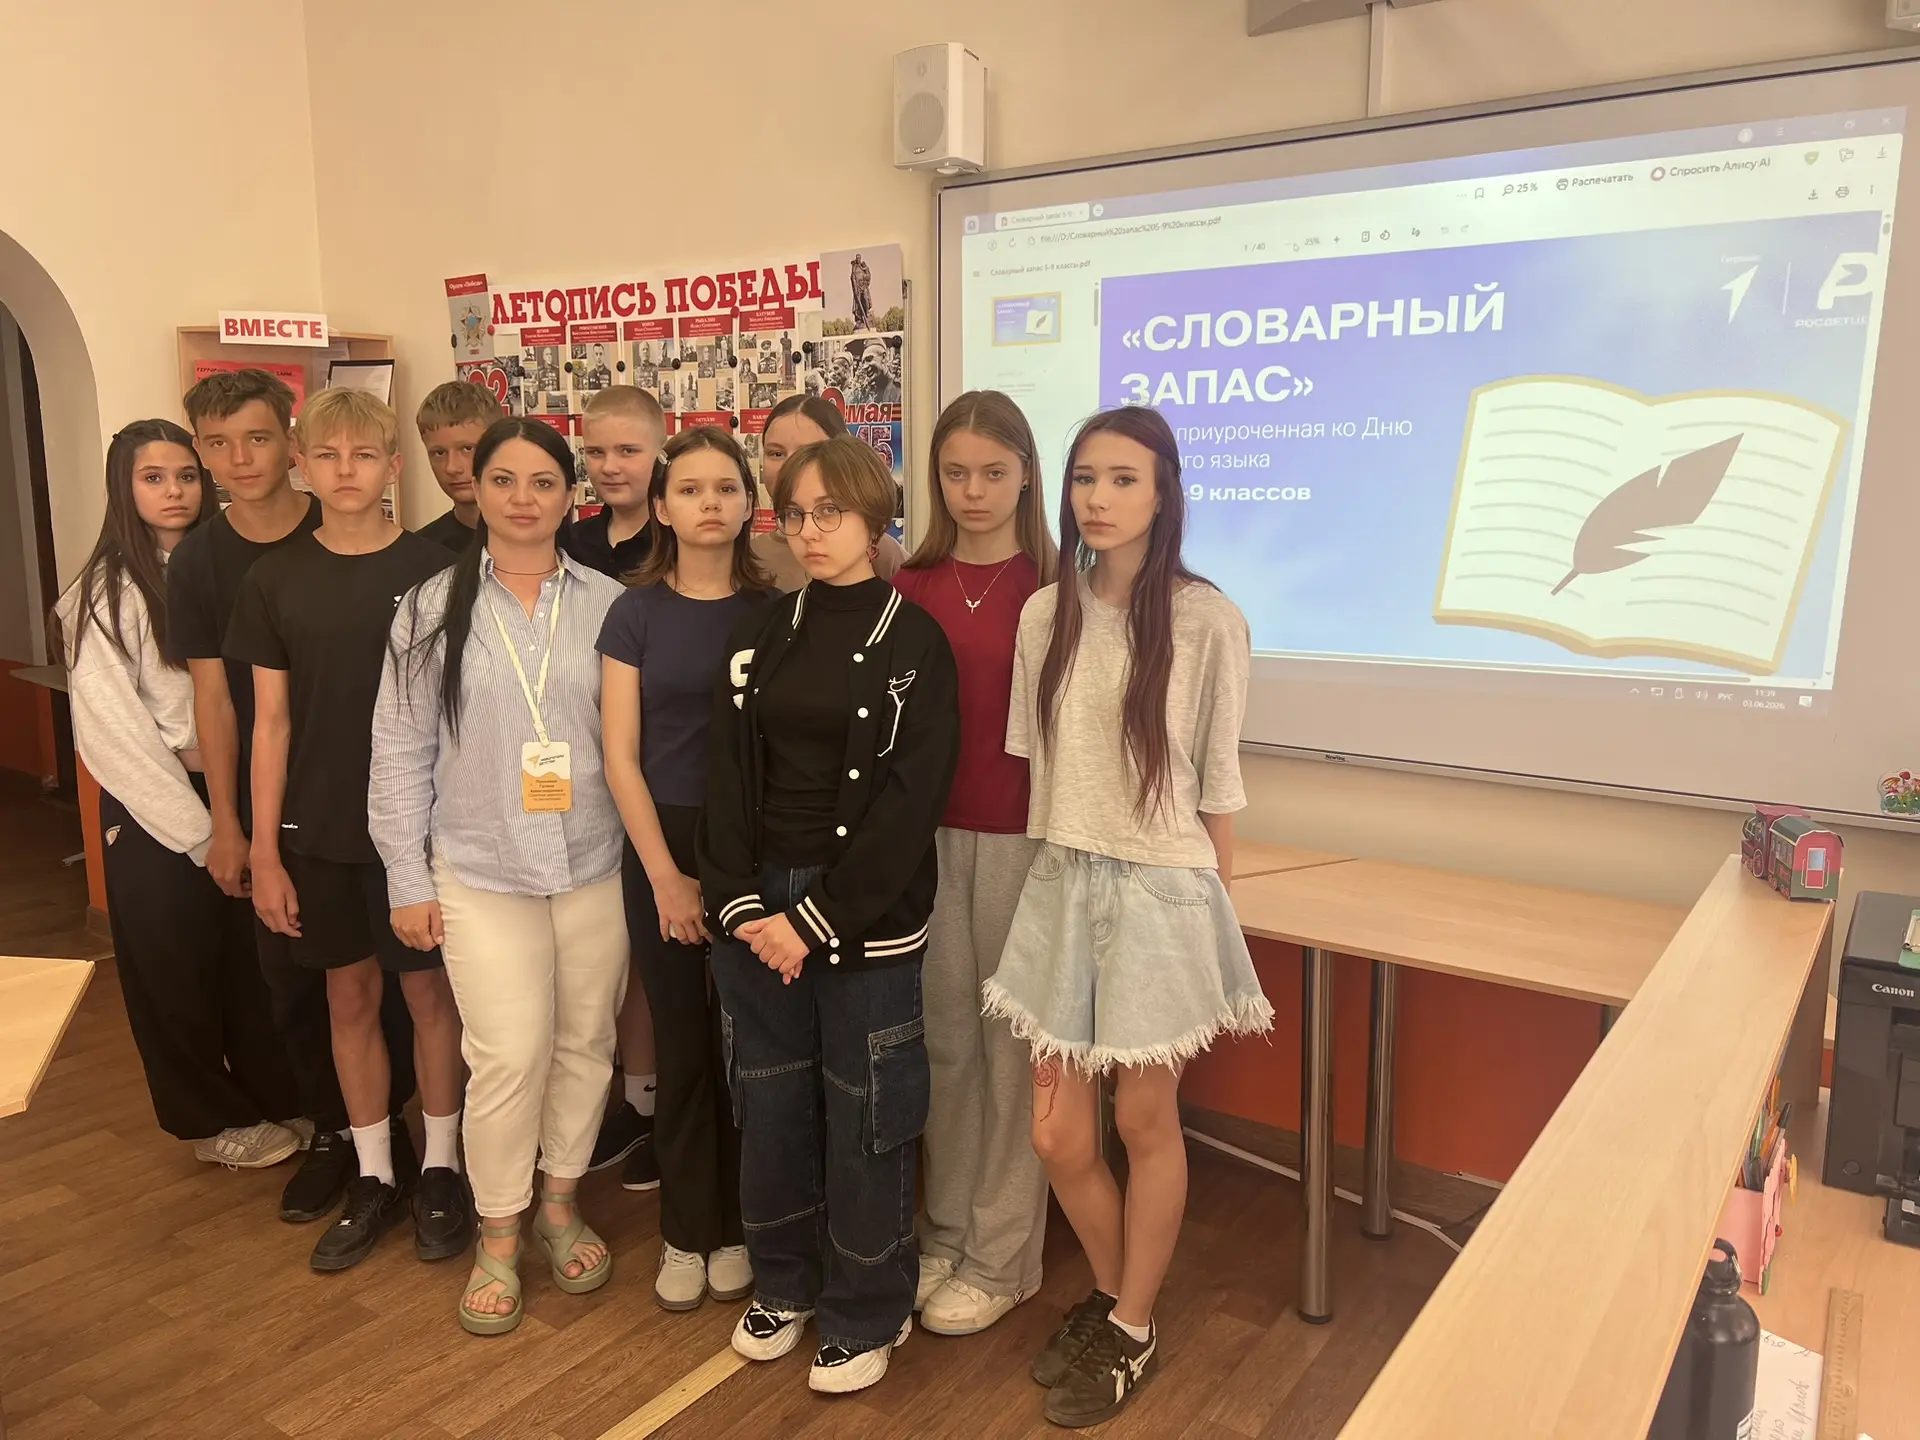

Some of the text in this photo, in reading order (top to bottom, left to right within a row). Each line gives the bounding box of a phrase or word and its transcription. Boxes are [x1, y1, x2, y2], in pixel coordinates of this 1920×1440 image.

[1670, 164, 1720, 178] Спросить
[1722, 160, 1757, 173] Алису
[1572, 173, 1634, 187] Распечатать
[492, 261, 822, 325] ЛЕТОПИСЬ ПОБЕДЫ
[1122, 281, 1505, 352] «СЛОВАРНЫЙ
[224, 318, 323, 339] ВМЕСТЕ
[1120, 365, 1314, 408] ЗАПАС»
[845, 402, 893, 424] мая
[1176, 417, 1413, 444] приуроченная ко Дню
[1210, 452, 1270, 468] языка
[1209, 483, 1311, 500] классов
[1871, 983, 1915, 997] Canon
